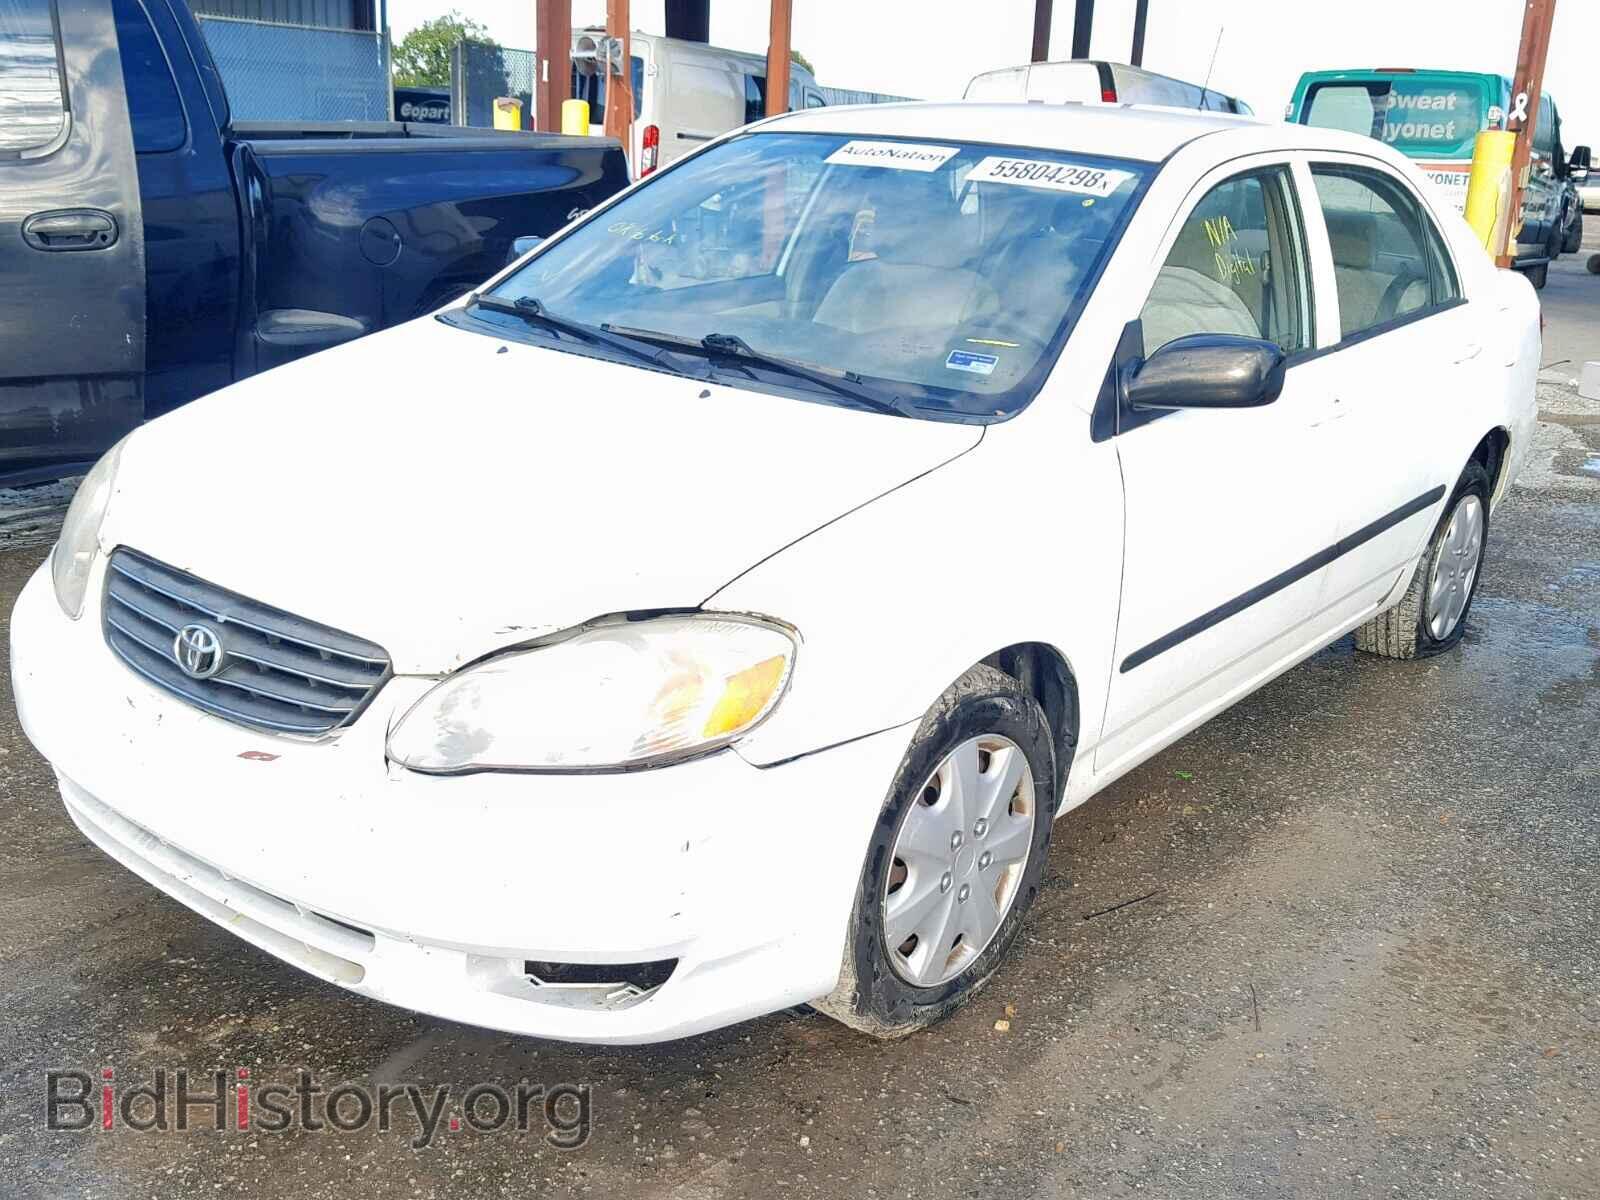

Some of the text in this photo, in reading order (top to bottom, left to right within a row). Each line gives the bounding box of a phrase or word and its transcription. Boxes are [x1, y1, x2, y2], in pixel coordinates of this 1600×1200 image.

[1387, 91, 1457, 110] Sweat
[401, 102, 450, 121] Copart
[843, 146, 946, 163] AutoNation
